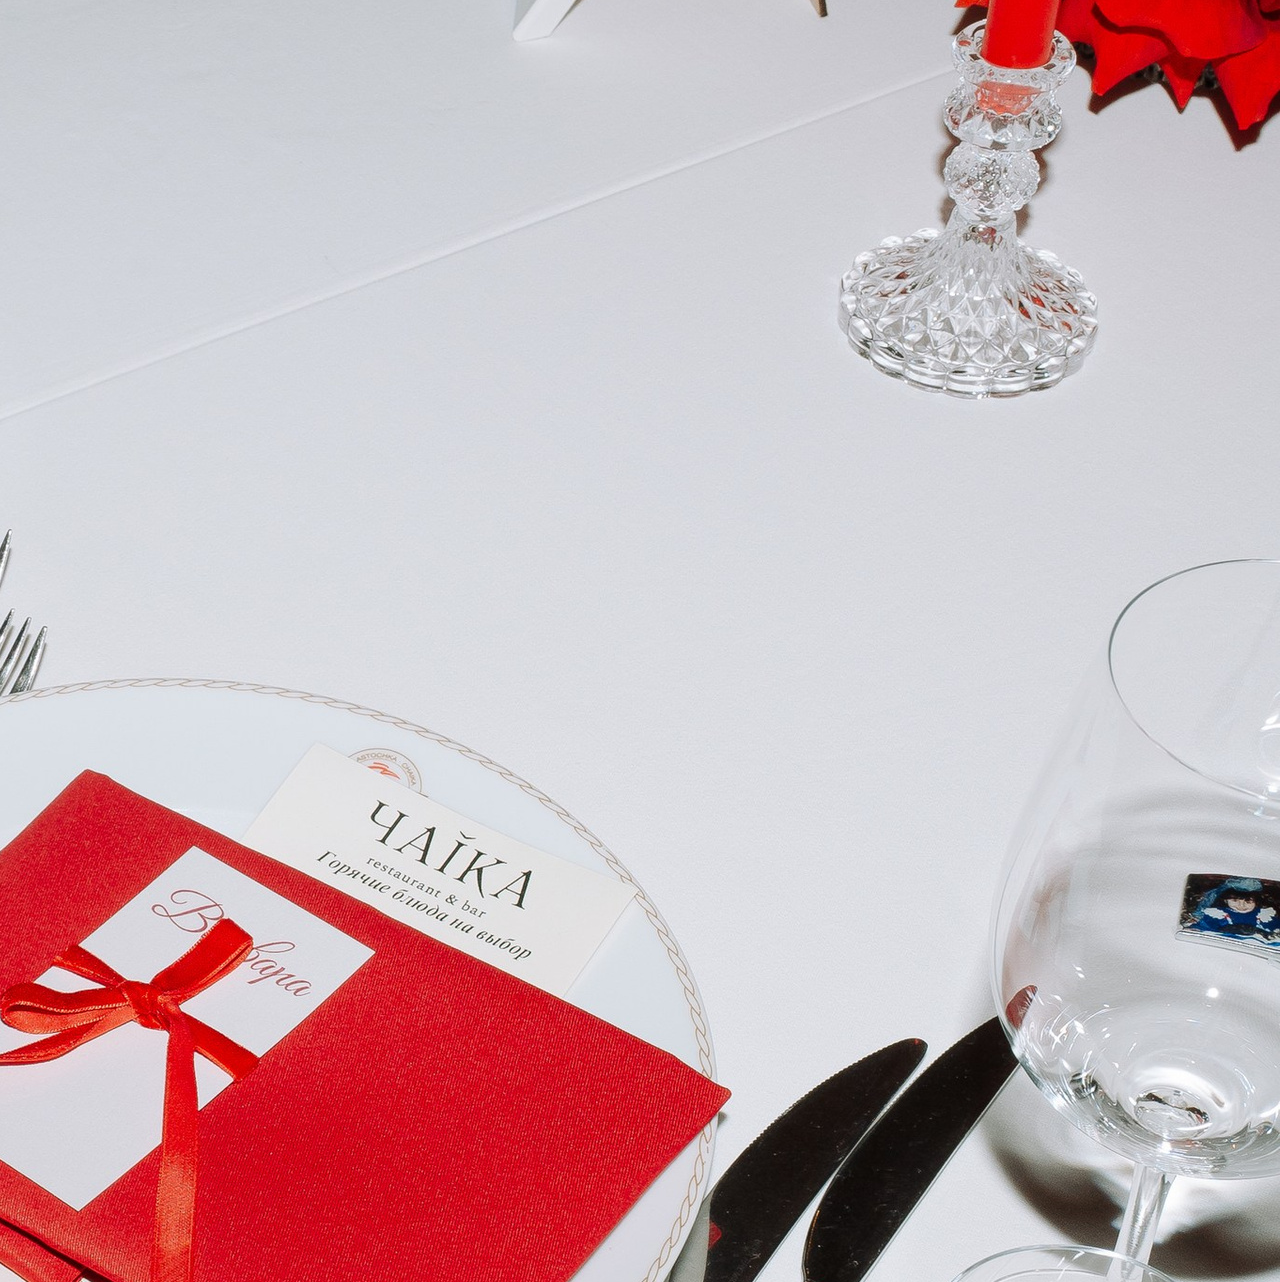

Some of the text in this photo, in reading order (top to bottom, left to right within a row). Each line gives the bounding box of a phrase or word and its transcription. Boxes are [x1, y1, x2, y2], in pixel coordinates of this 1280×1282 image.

[356, 752, 398, 763] ASTOCHKA
[316, 849, 533, 962] Горячие блюда на выбор
[366, 855, 487, 920] restaurant & bar
[151, 889, 312, 997] Ввара
